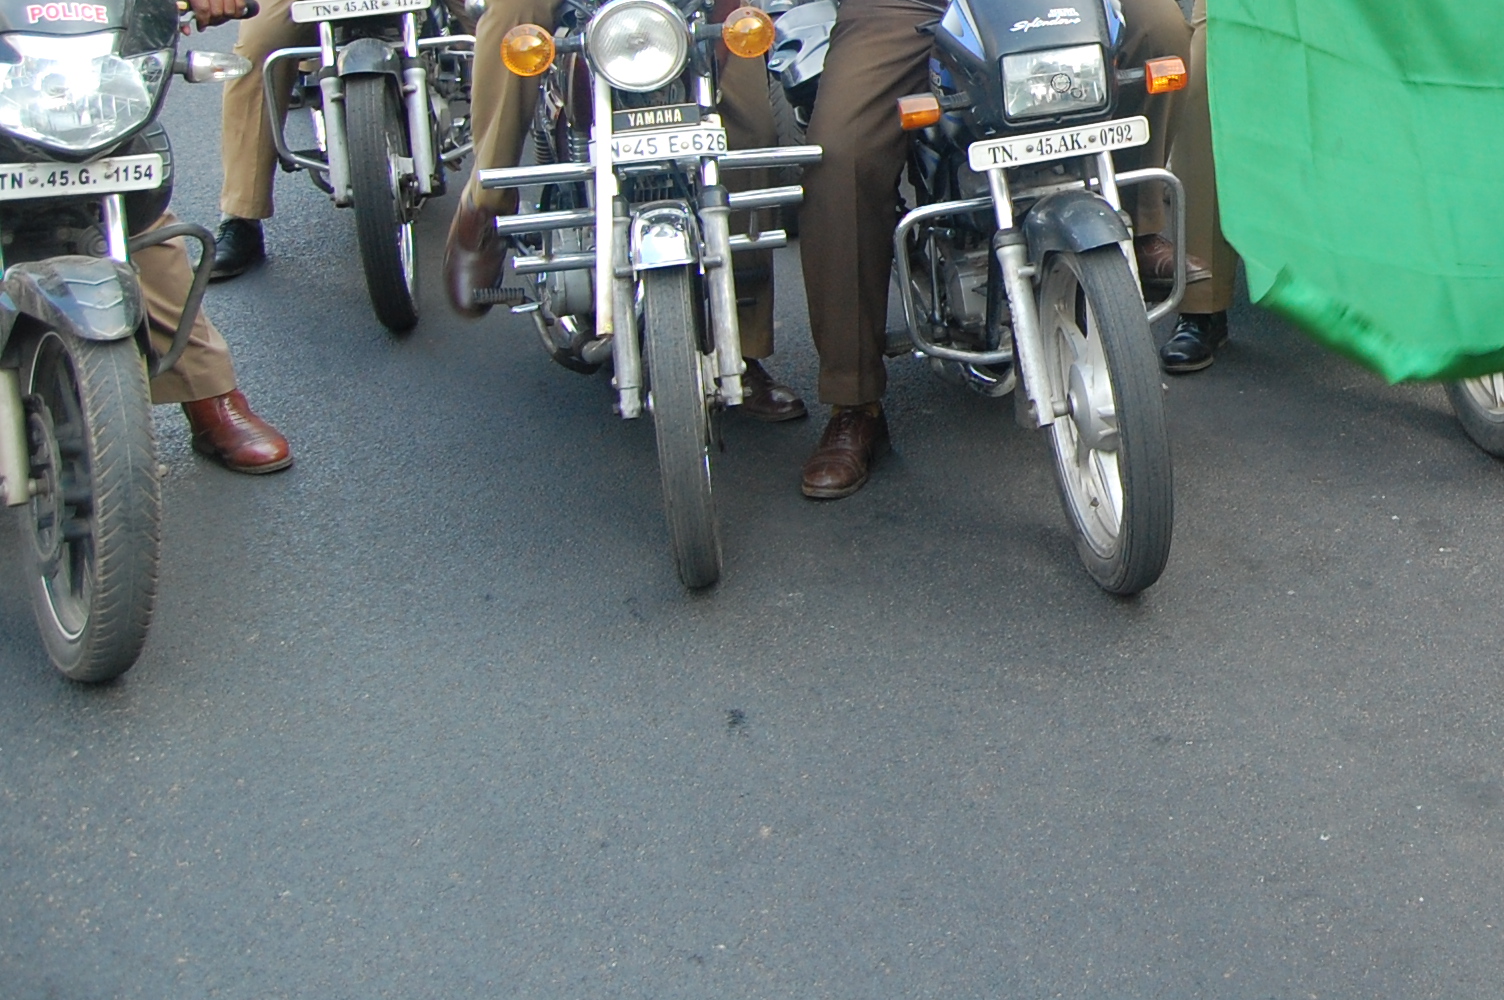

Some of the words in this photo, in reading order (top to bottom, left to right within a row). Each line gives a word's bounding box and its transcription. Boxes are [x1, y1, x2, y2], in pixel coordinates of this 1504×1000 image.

[27, 2, 109, 24] POLICE
[313, 5, 332, 17] TN
[628, 108, 682, 127] YAMAHA
[1100, 124, 1133, 146] 0792
[634, 138, 658, 156] 45
[669, 136, 680, 153] E
[113, 164, 153, 182] 1154
